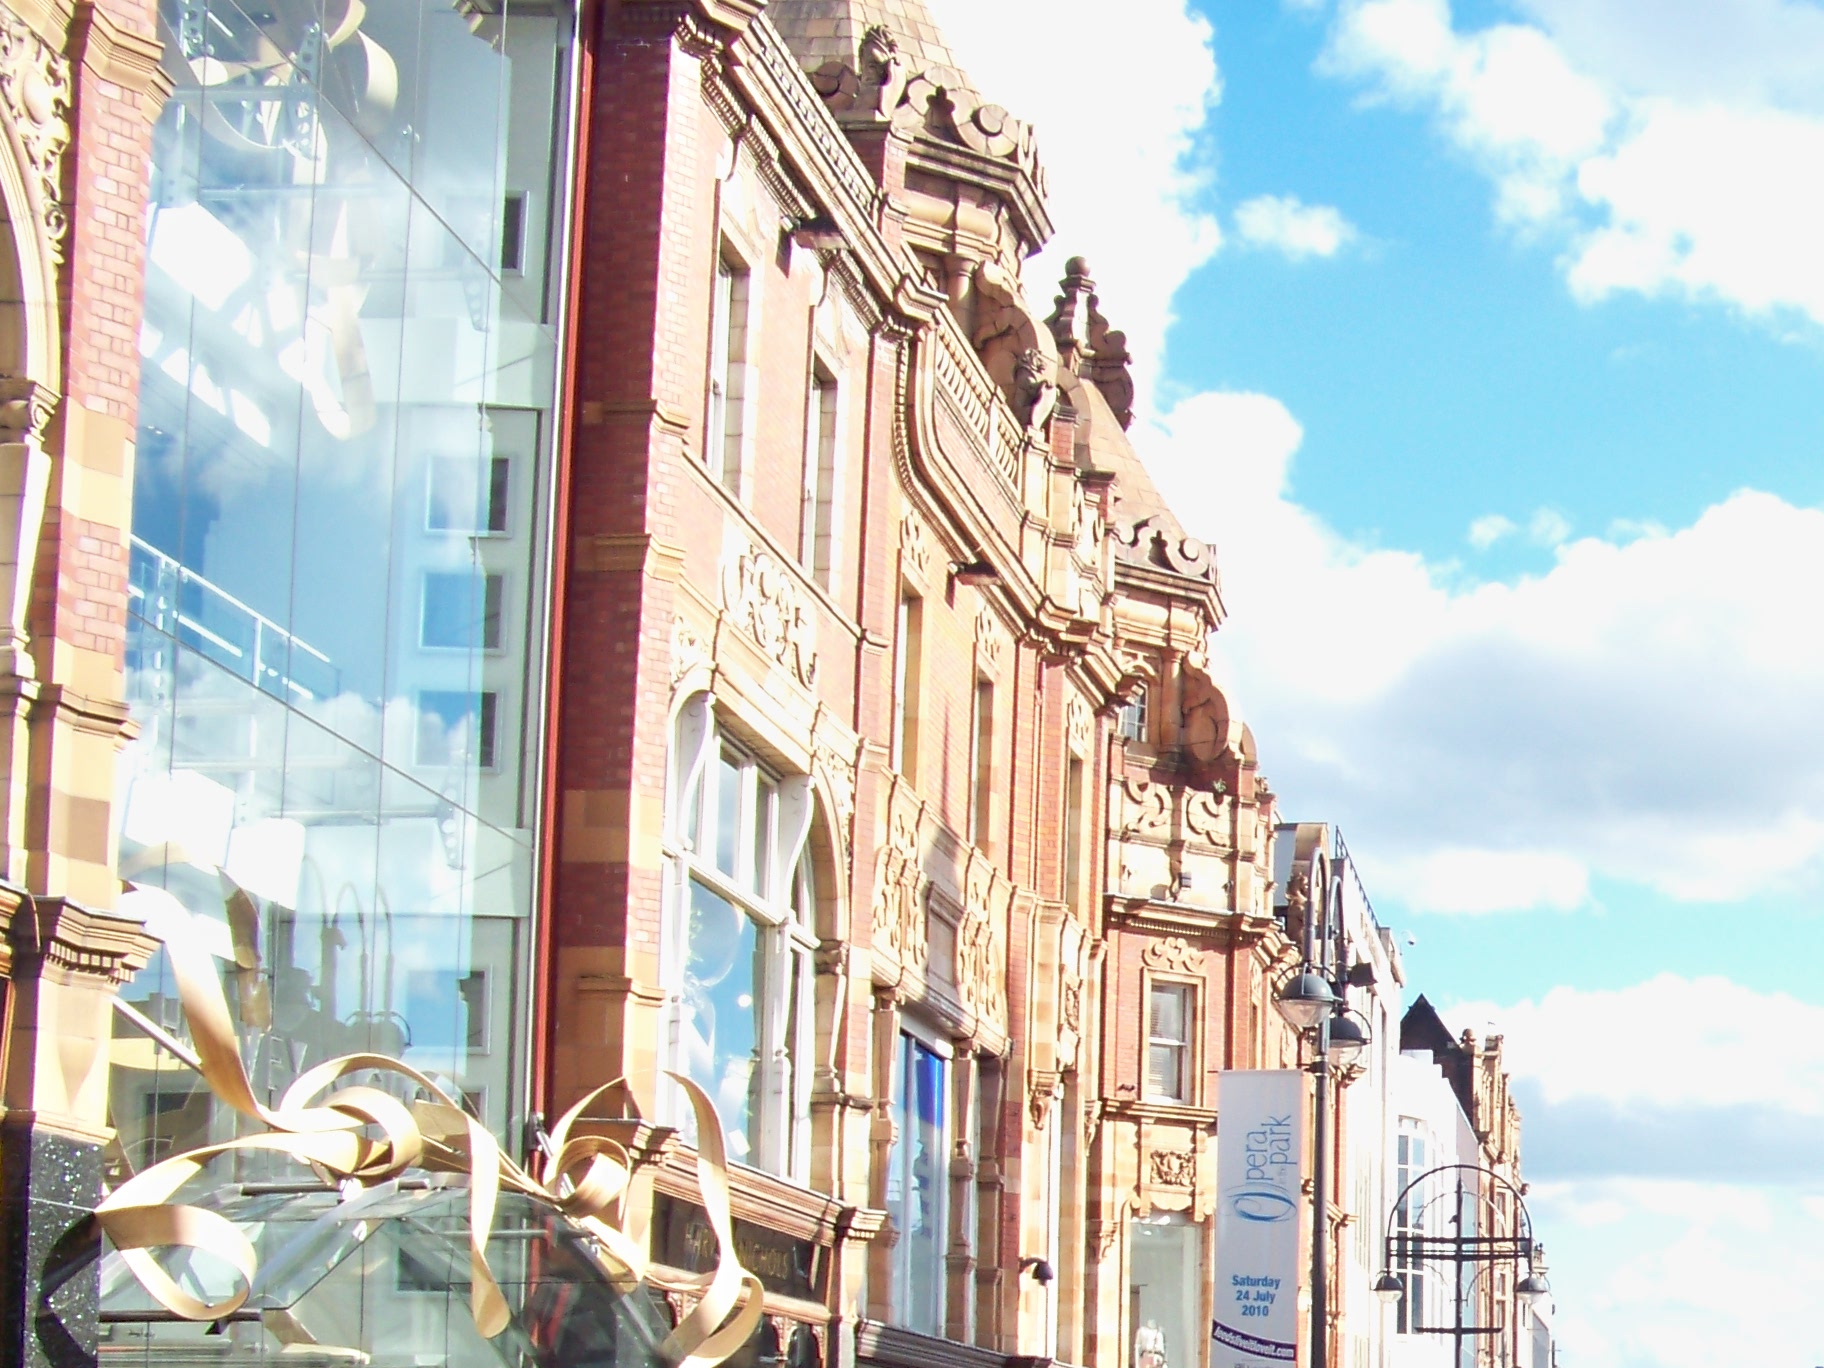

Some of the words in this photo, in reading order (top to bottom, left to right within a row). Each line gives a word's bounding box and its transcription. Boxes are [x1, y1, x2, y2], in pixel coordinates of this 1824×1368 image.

[1261, 1114, 1298, 1165] park
[1232, 1275, 1281, 1290] Saturday
[1236, 1290, 1250, 1301] 24
[1253, 1290, 1276, 1304] July
[1242, 1305, 1269, 1317] 2010
